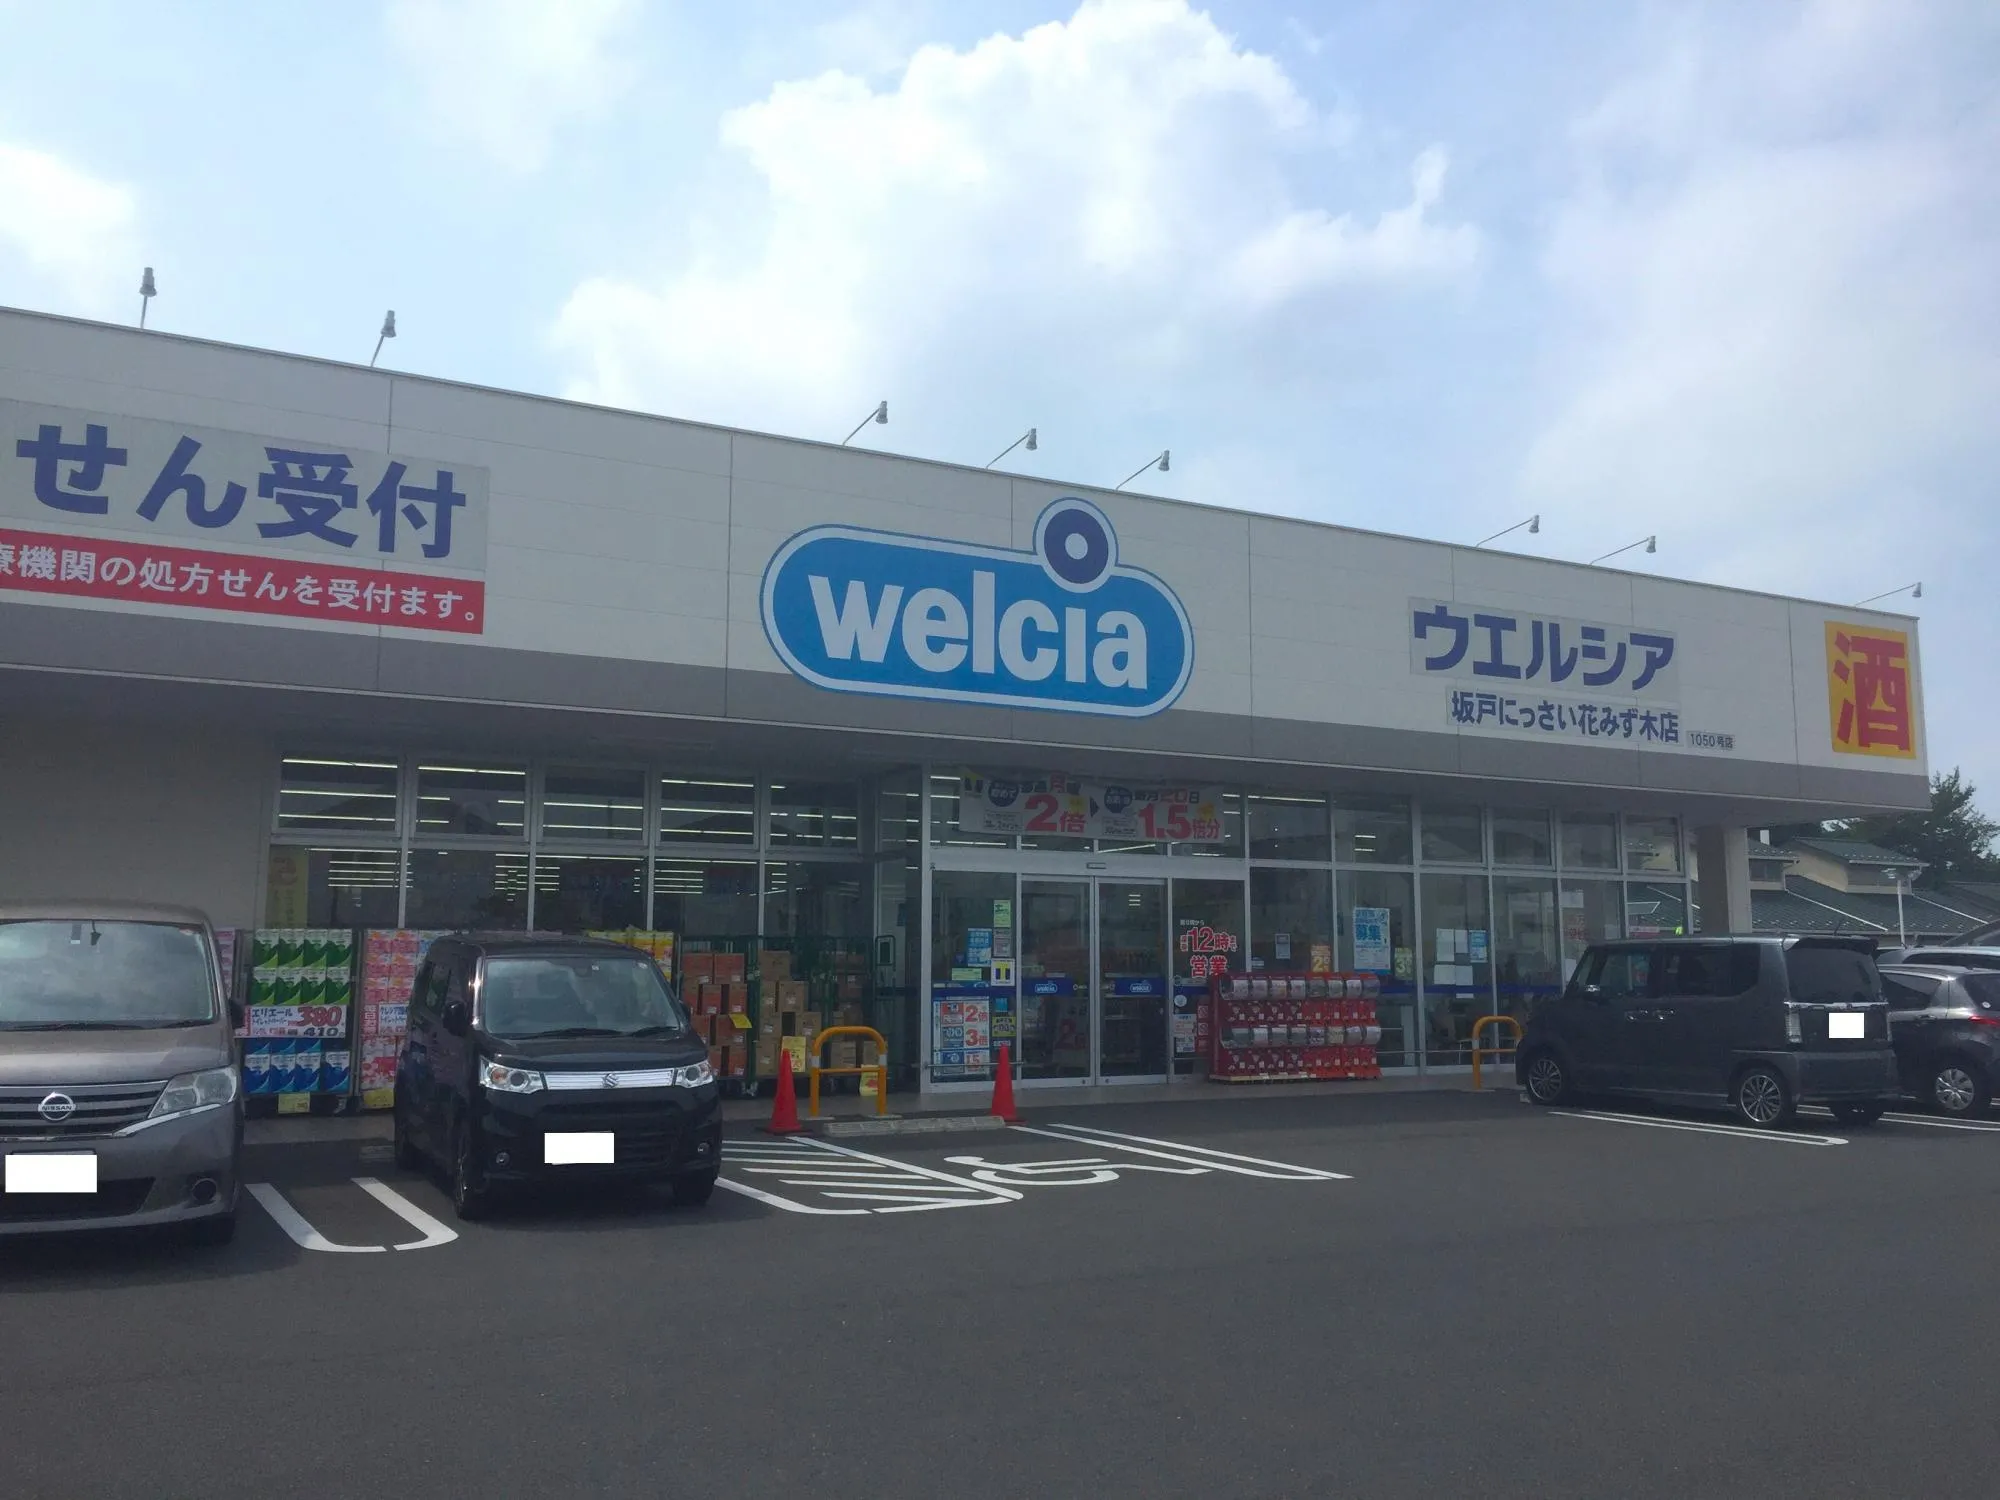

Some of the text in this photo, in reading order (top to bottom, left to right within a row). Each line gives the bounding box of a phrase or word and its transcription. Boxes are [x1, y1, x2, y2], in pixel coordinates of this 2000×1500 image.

[16, 423, 467, 559] せん受付
[808, 569, 1148, 689] welcia
[1413, 605, 1675, 691] ウエルシア
[1452, 690, 1679, 744] 坂戸にっさい花みず木店
[1833, 630, 1911, 753] 酒
[1690, 733, 1734, 749] 1050号店
[41, 1104, 73, 1112] NISSAN
